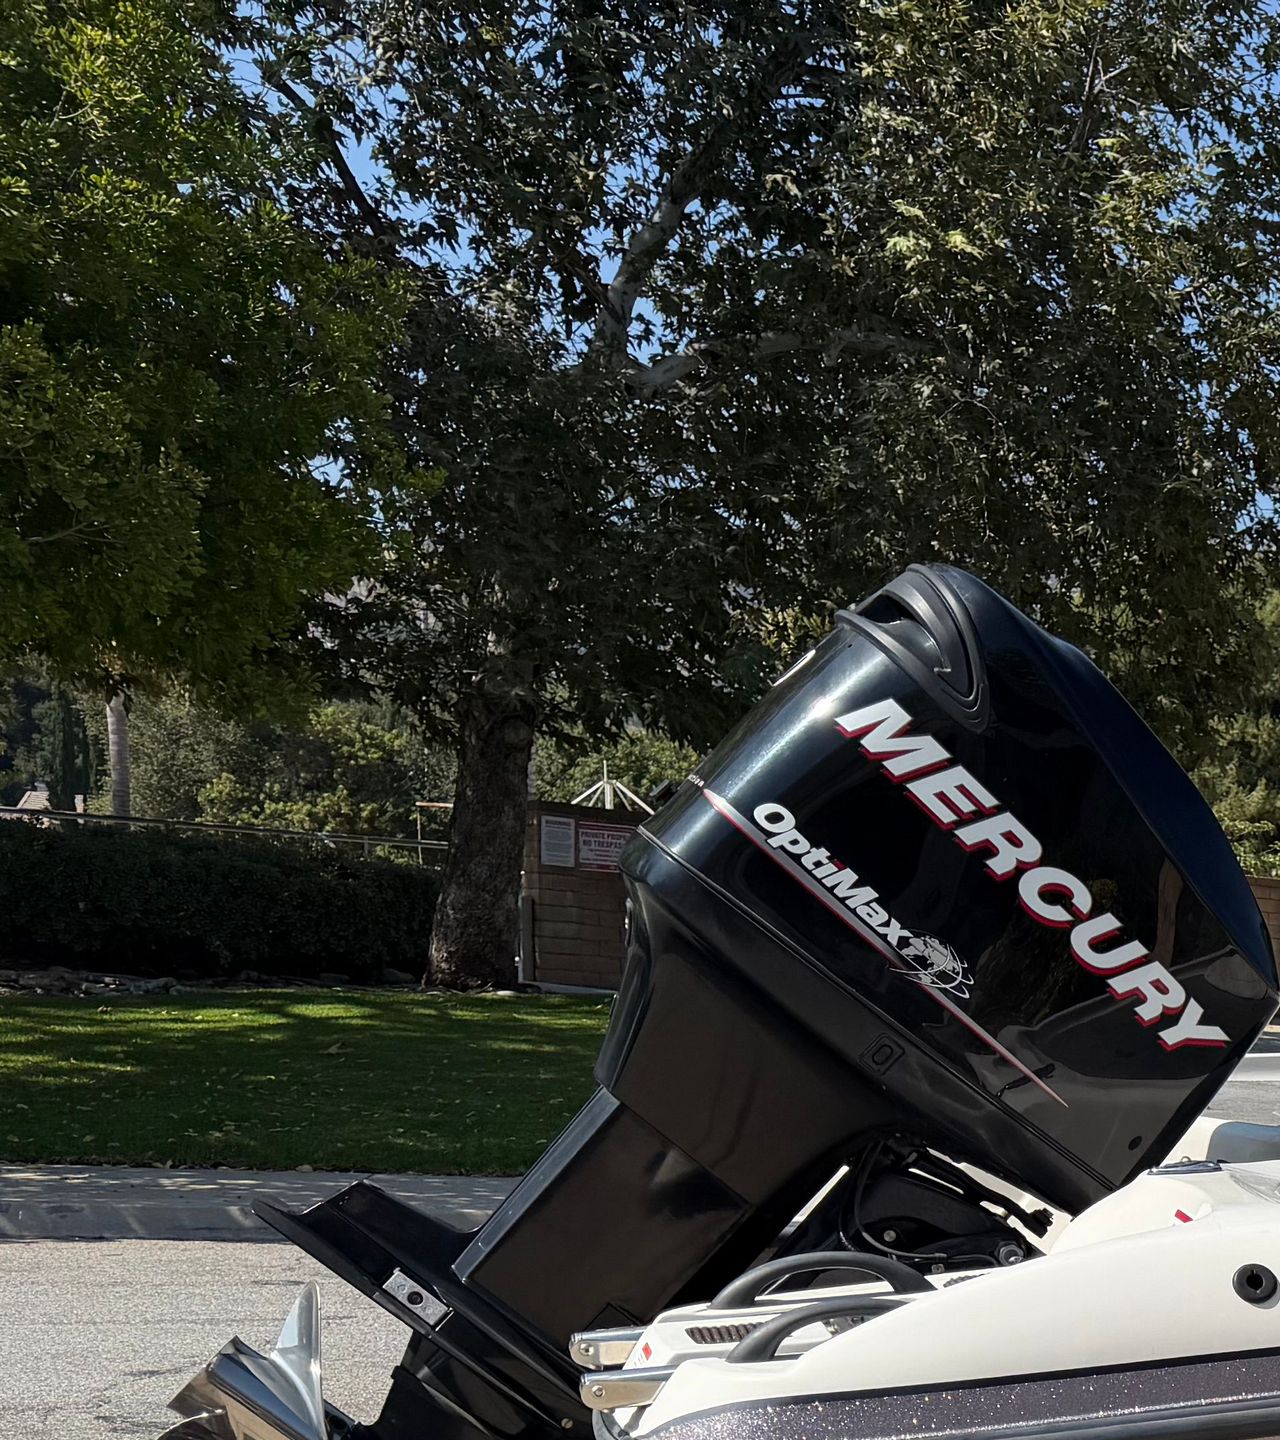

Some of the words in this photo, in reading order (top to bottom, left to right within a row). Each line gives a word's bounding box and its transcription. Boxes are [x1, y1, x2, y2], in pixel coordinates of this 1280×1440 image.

[581, 831, 605, 839] PRIVATE
[606, 833, 627, 841] PROPE
[583, 839, 592, 847] NO
[594, 840, 622, 849] TRESPAS
[753, 802, 914, 947] OptiMax
[834, 697, 1231, 1052] MERCURY
